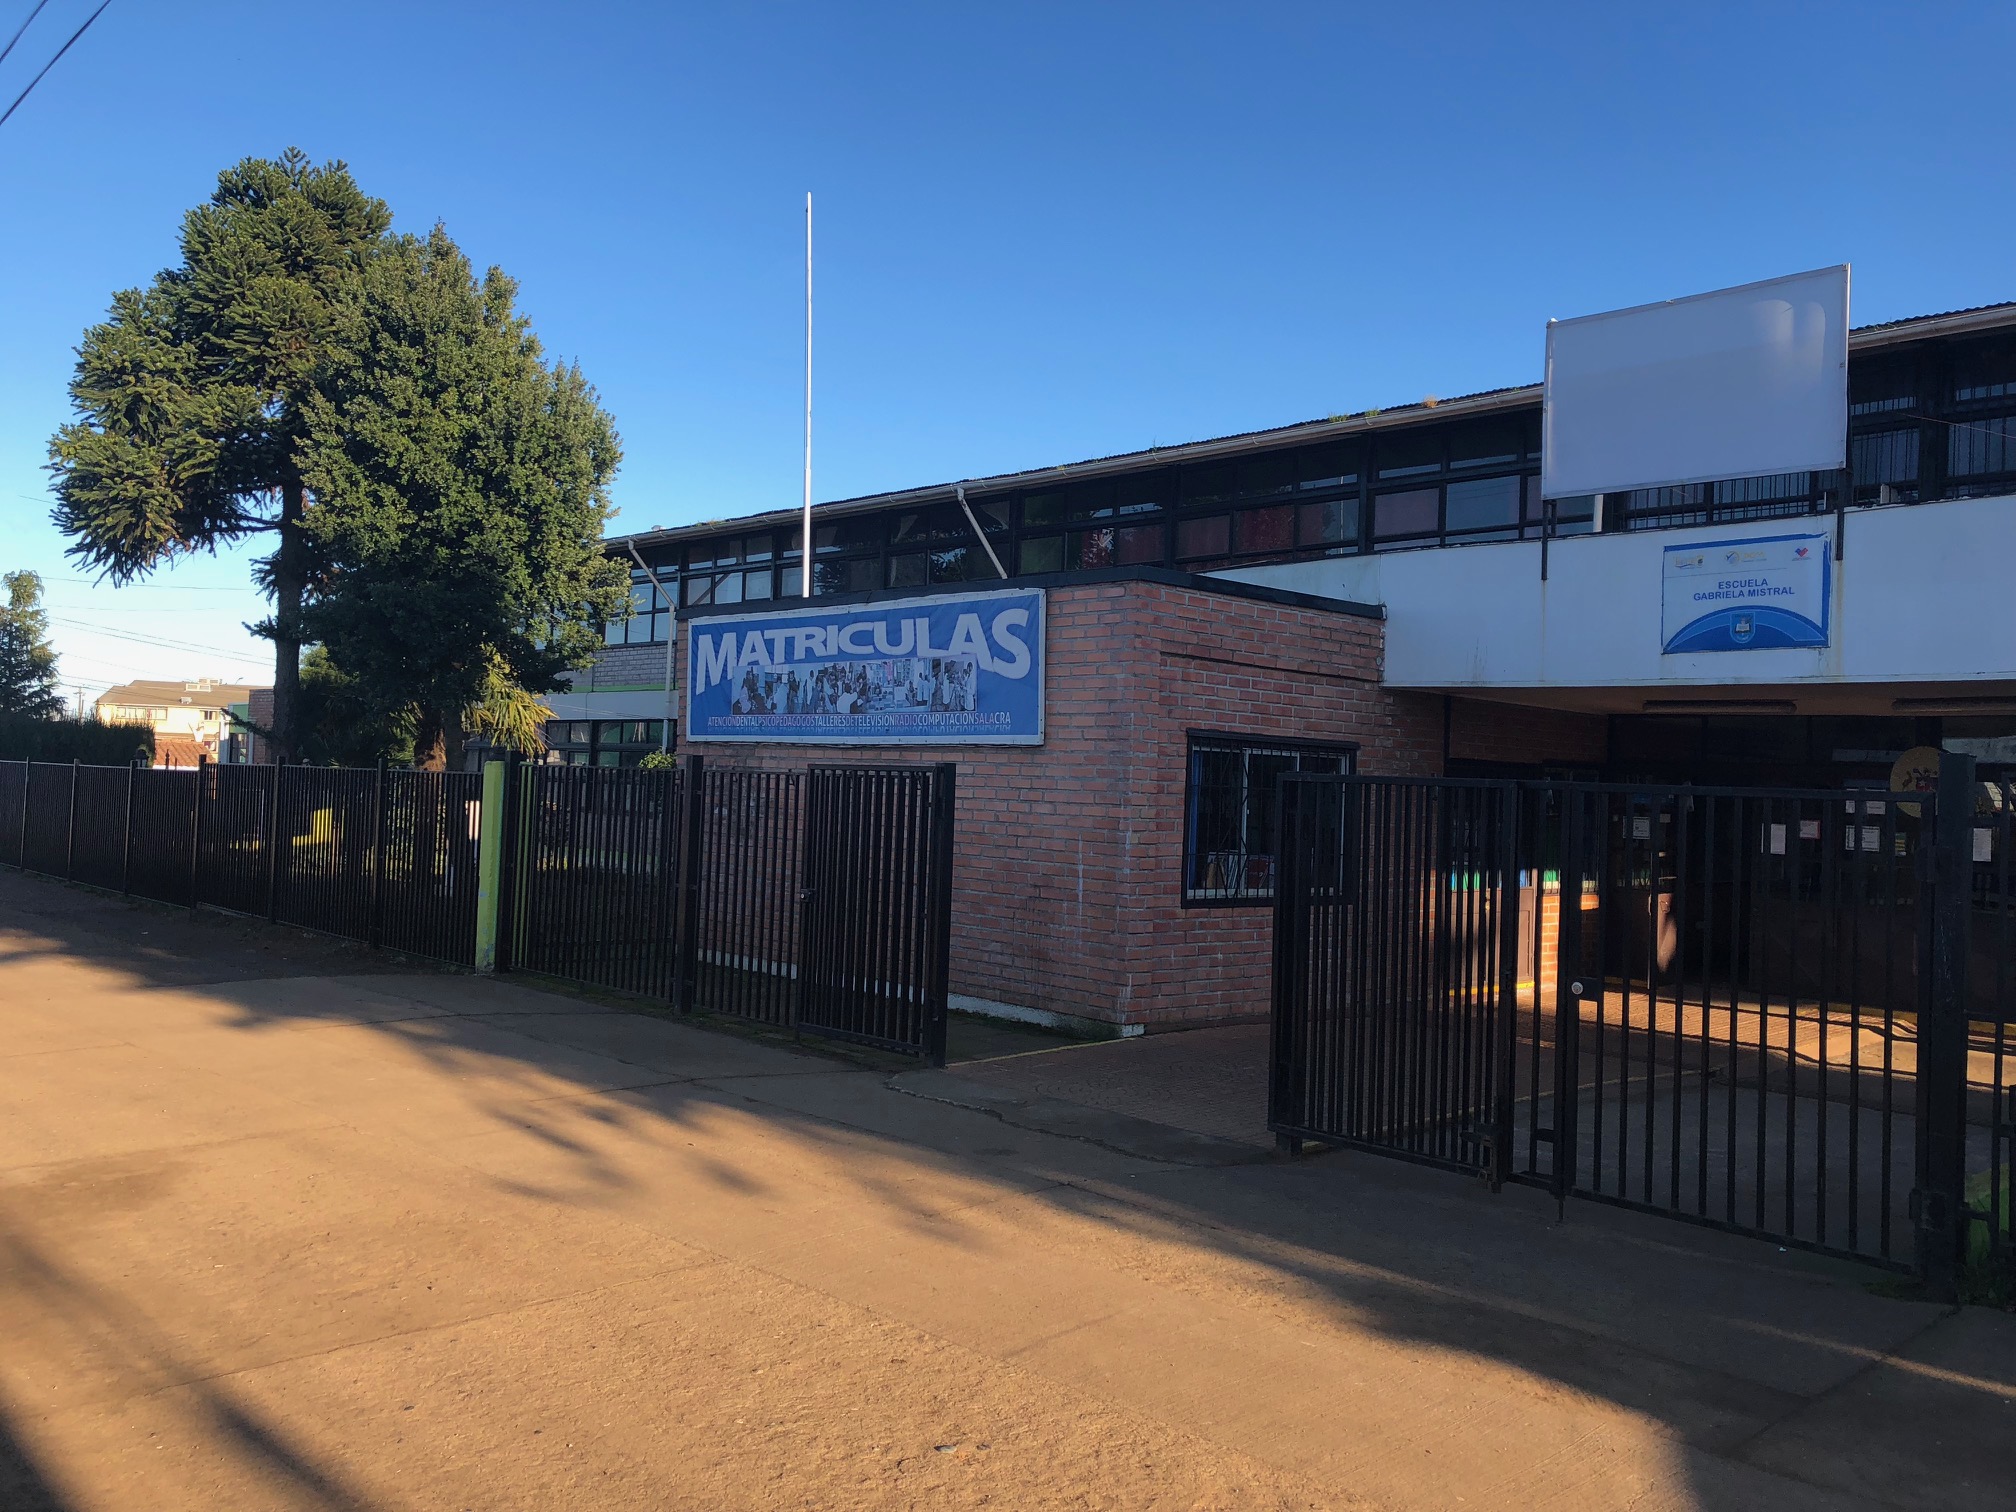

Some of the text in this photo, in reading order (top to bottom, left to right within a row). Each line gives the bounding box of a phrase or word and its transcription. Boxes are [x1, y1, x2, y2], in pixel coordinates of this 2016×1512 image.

[1718, 578, 1768, 590] ESCUELA
[1693, 586, 1795, 601] GABRIELA MISTRAL
[695, 608, 1032, 696] MATRICULAS
